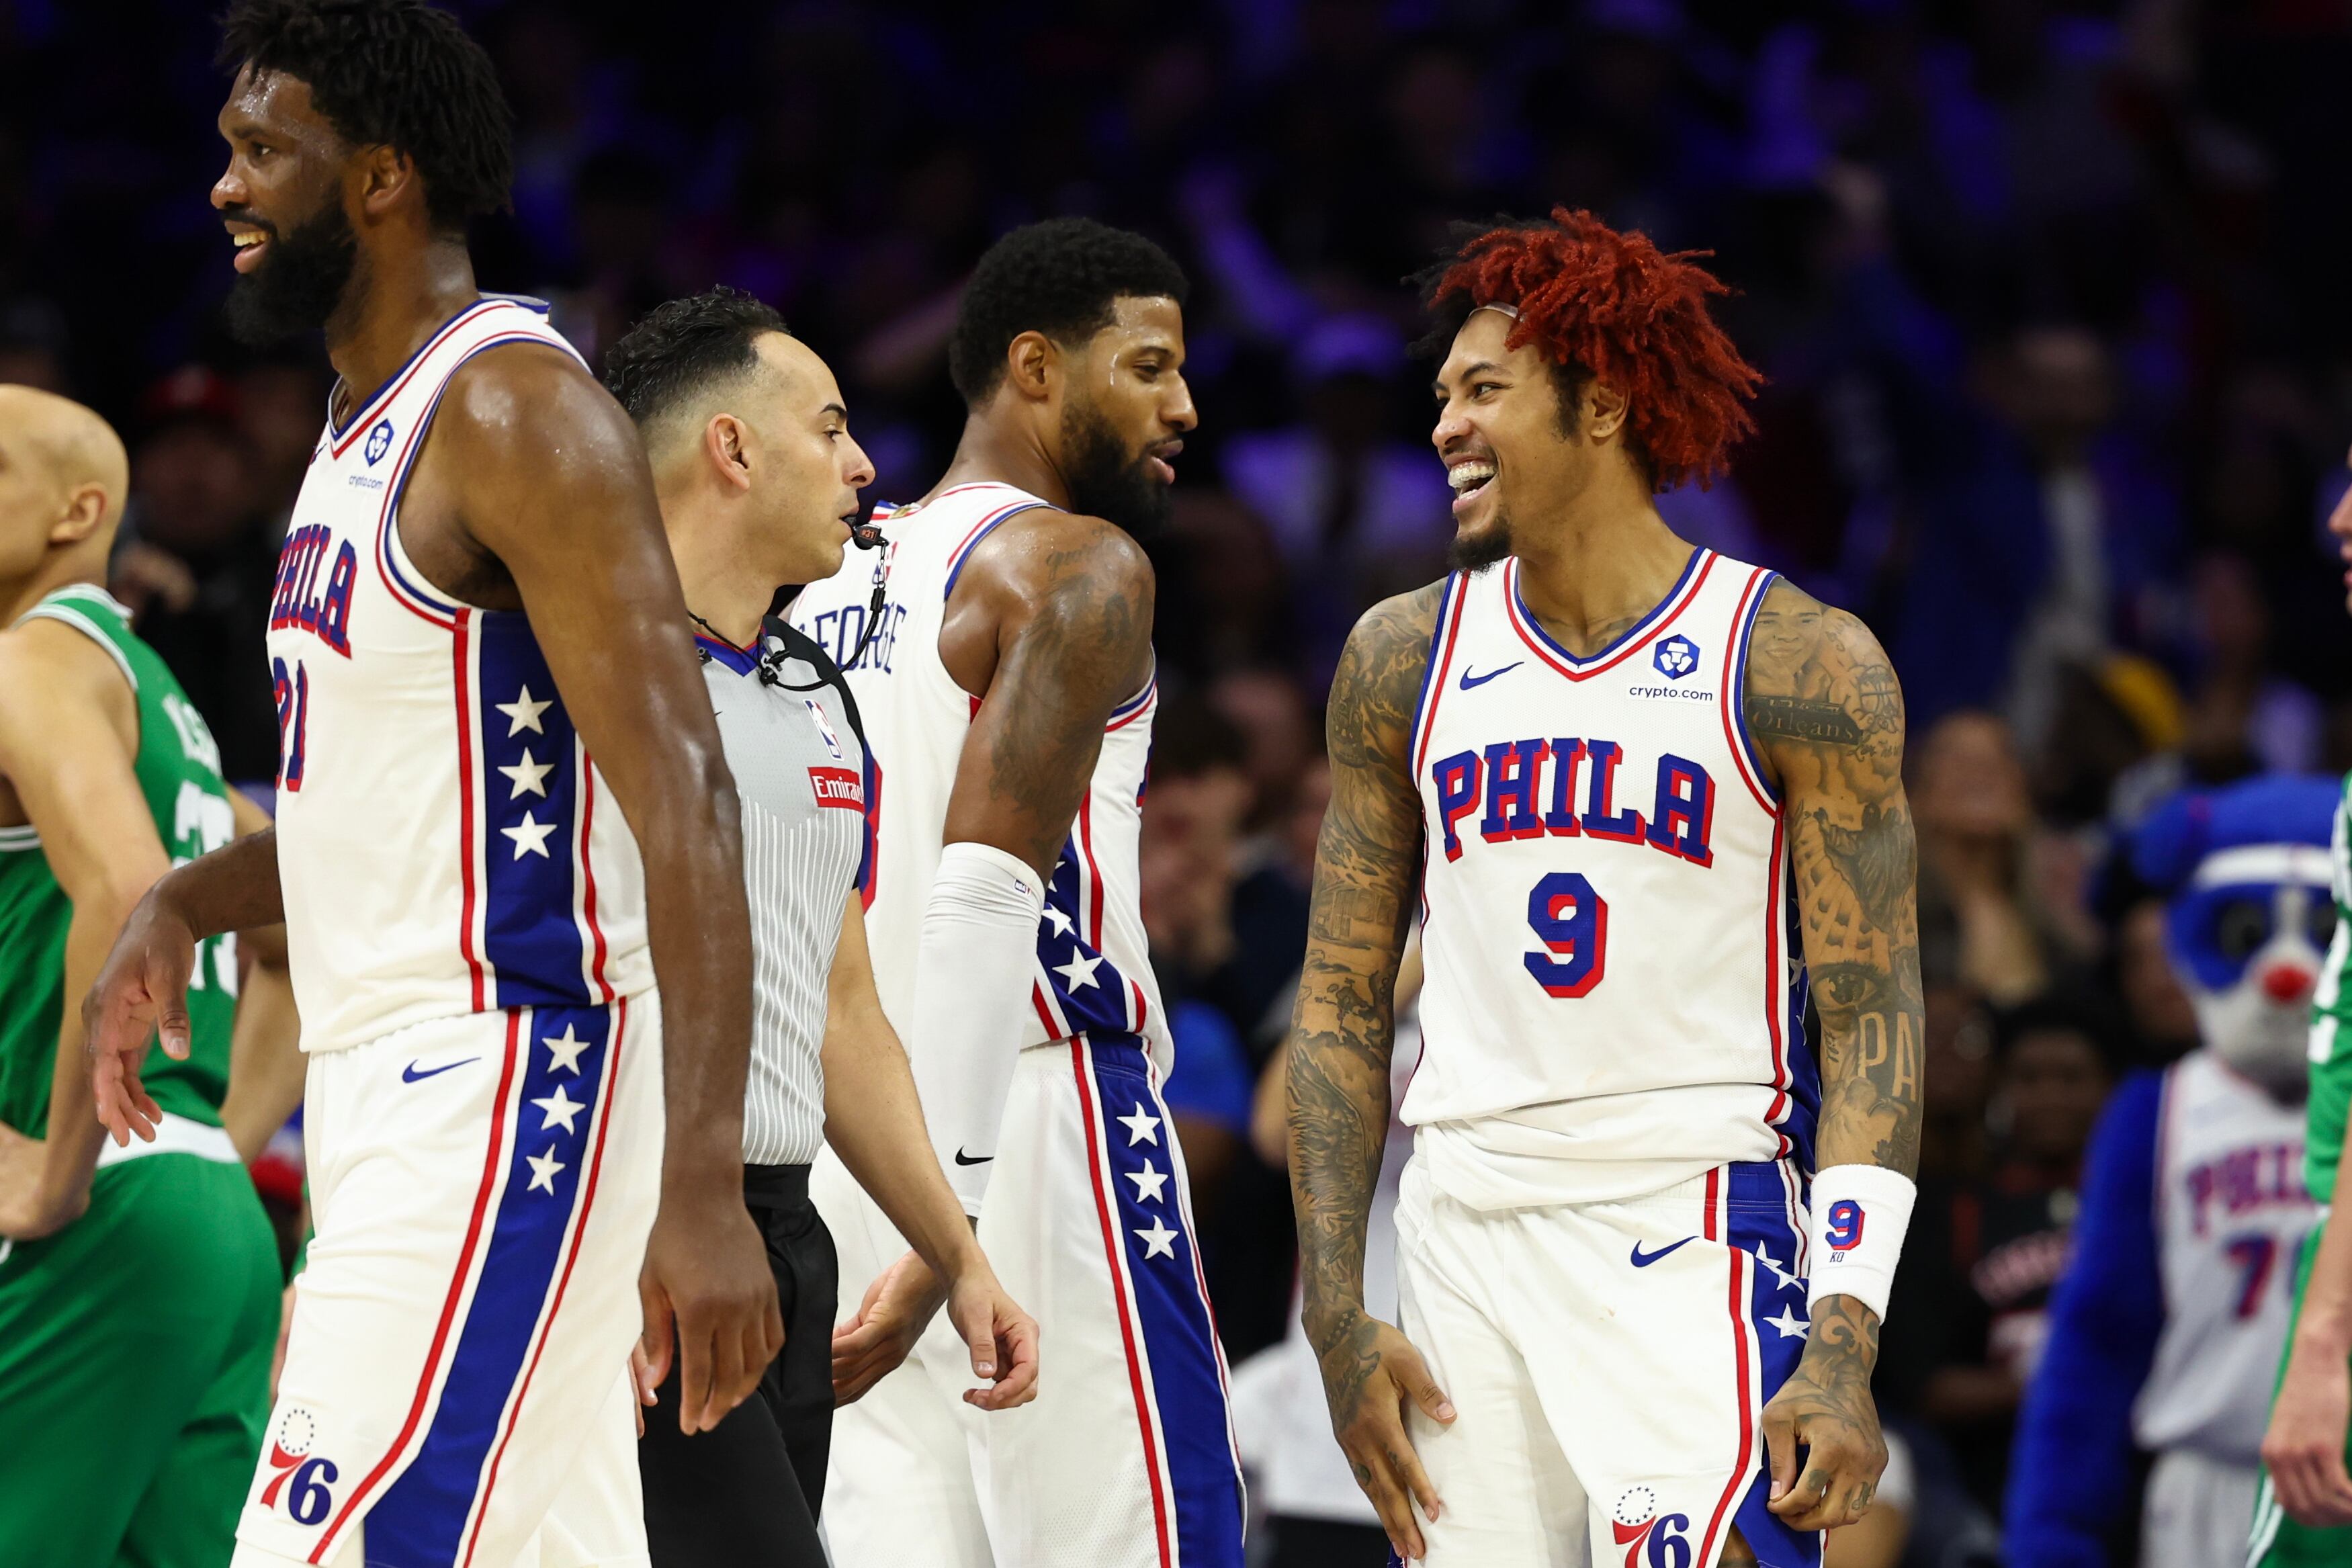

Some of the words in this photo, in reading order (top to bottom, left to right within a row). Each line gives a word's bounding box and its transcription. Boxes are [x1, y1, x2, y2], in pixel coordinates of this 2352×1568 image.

[348, 474, 384, 490] crypto.com
[271, 523, 357, 660] PHILA
[798, 601, 908, 675] EORGE
[1629, 686, 1713, 701] crypto.com
[1751, 708, 1854, 740] Orleans
[1432, 736, 1716, 869] PHILA
[1524, 872, 1608, 998] 9
[1825, 1199, 1866, 1251] 9
[1829, 1252, 1845, 1263] KO
[261, 1438, 339, 1526] 76
[1612, 1513, 1692, 1568] 76
